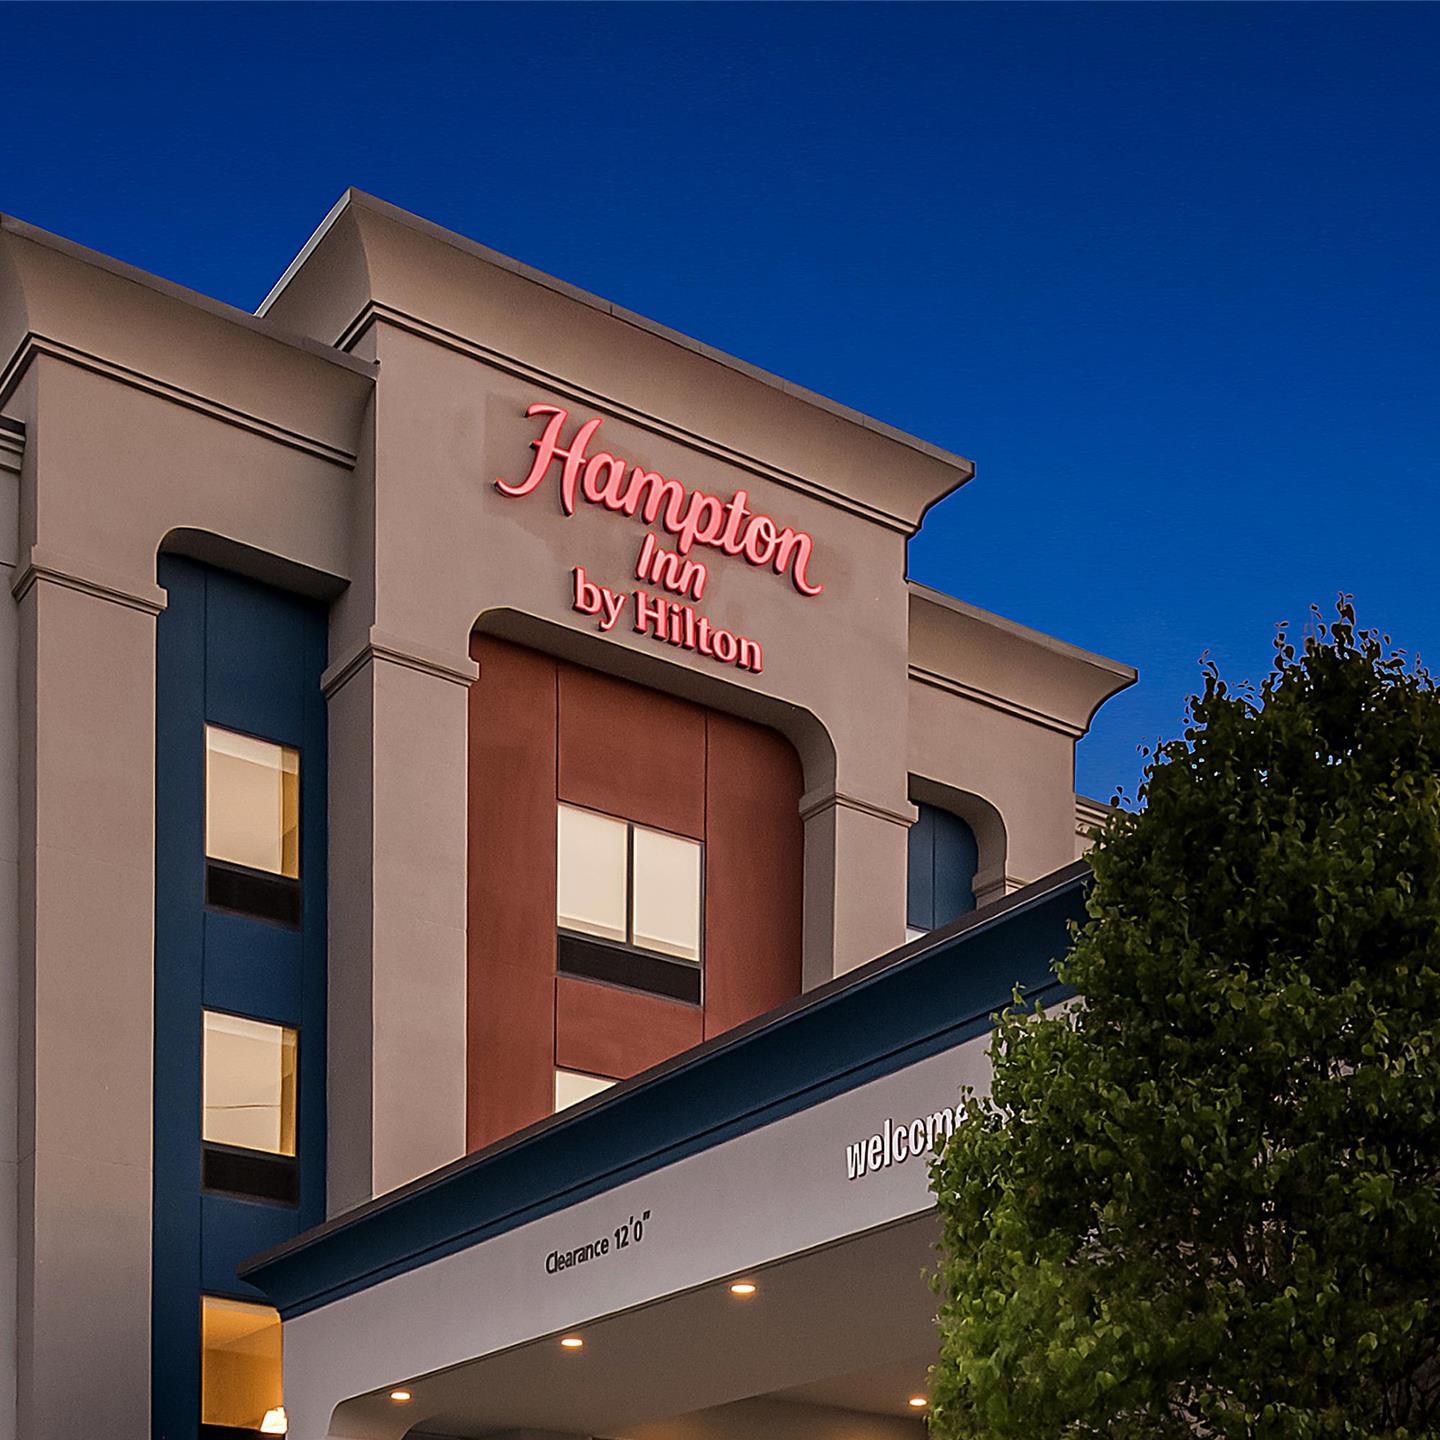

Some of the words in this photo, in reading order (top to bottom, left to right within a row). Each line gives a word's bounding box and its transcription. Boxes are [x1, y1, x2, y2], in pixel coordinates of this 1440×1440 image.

[494, 402, 825, 596] Hampton
[635, 531, 707, 600] Inn
[573, 566, 626, 632] by
[633, 590, 763, 673] Hilton
[545, 1238, 609, 1274] Clearance
